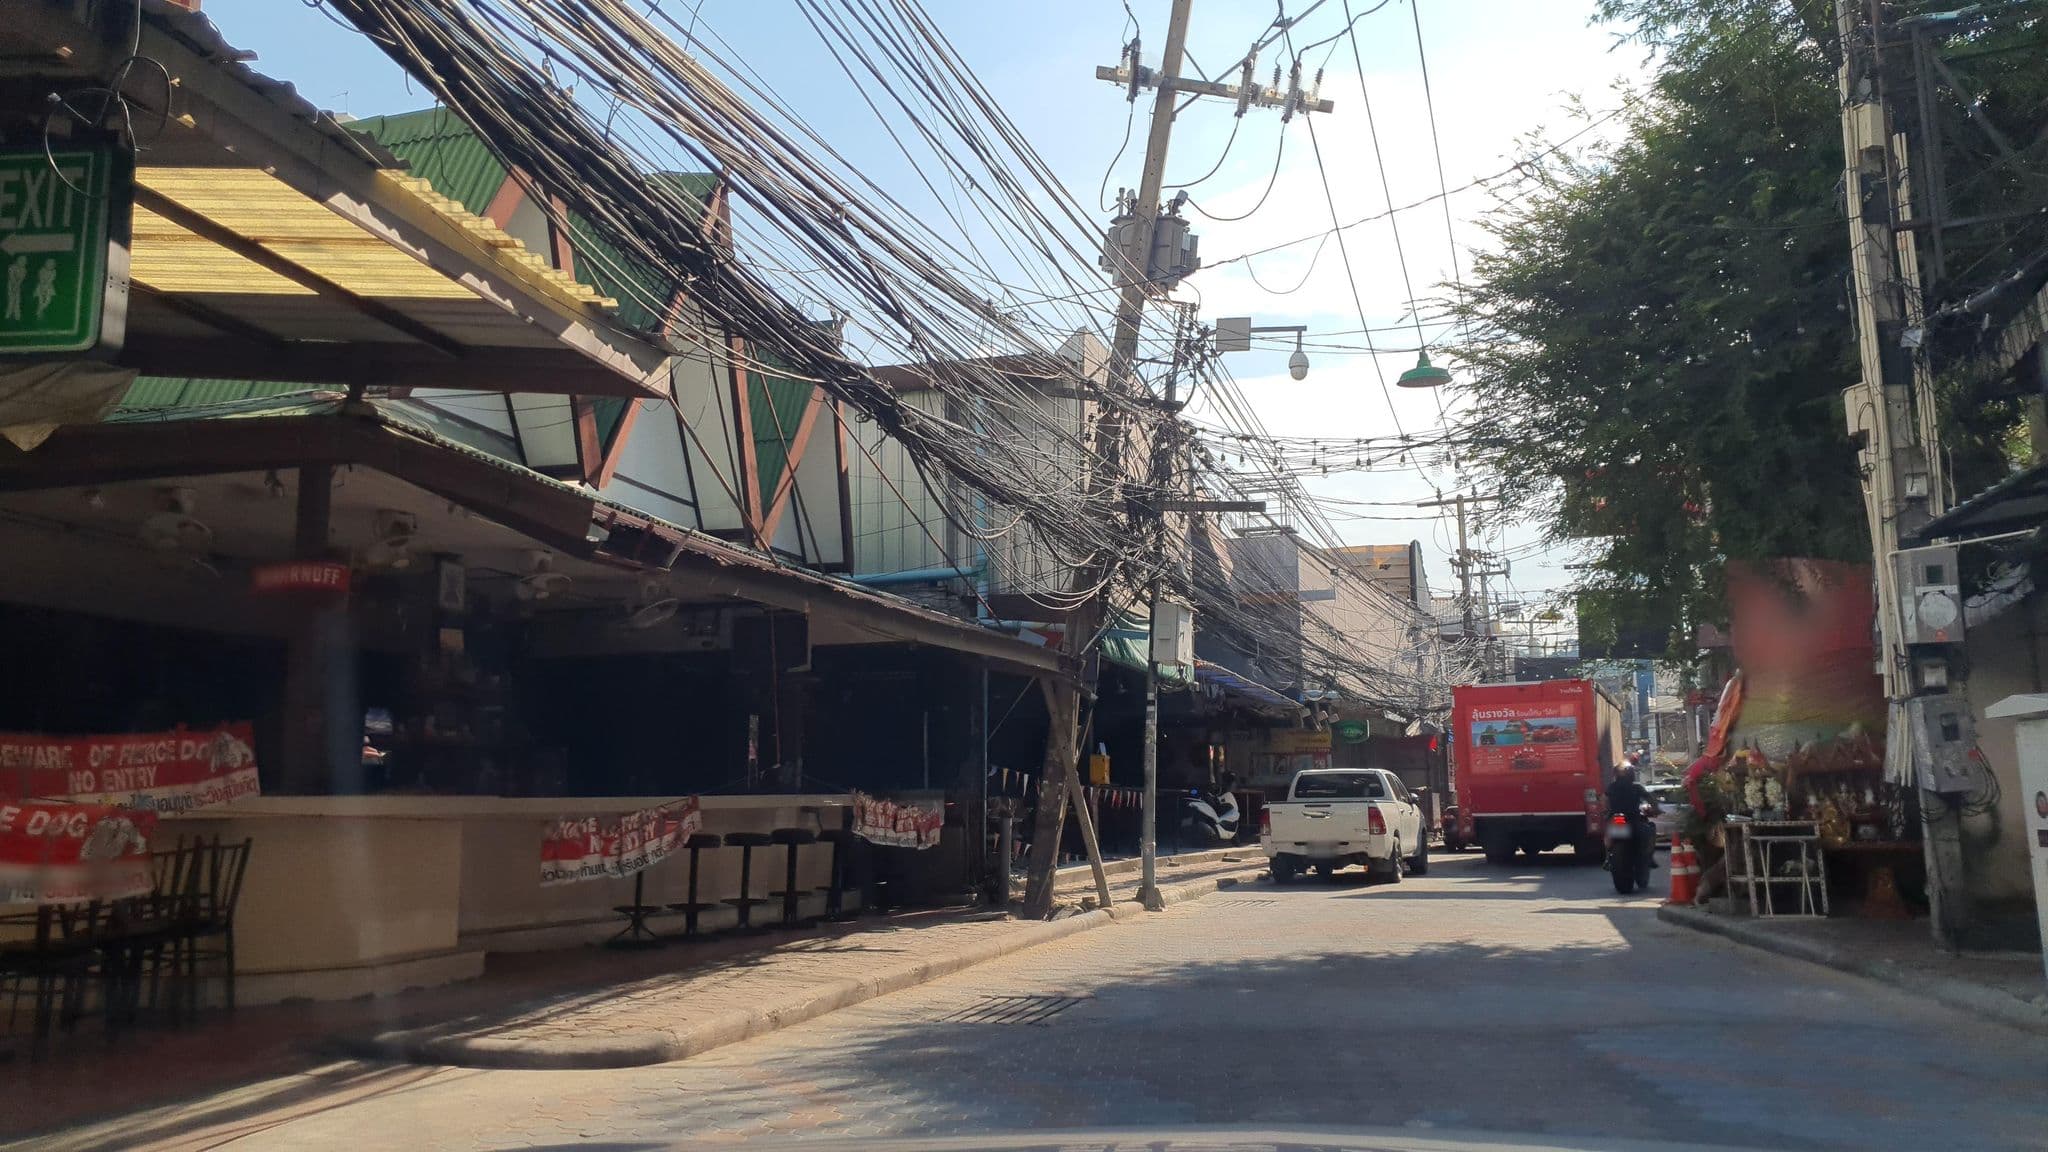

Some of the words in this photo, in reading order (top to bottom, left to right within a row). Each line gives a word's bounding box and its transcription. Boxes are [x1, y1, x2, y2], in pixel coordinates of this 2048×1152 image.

[0, 167, 84, 228] EXIT
[90, 746, 112, 767] OF
[69, 771, 95, 793] NO
[102, 766, 157, 792] ENTRY
[26, 811, 88, 837] DOG
